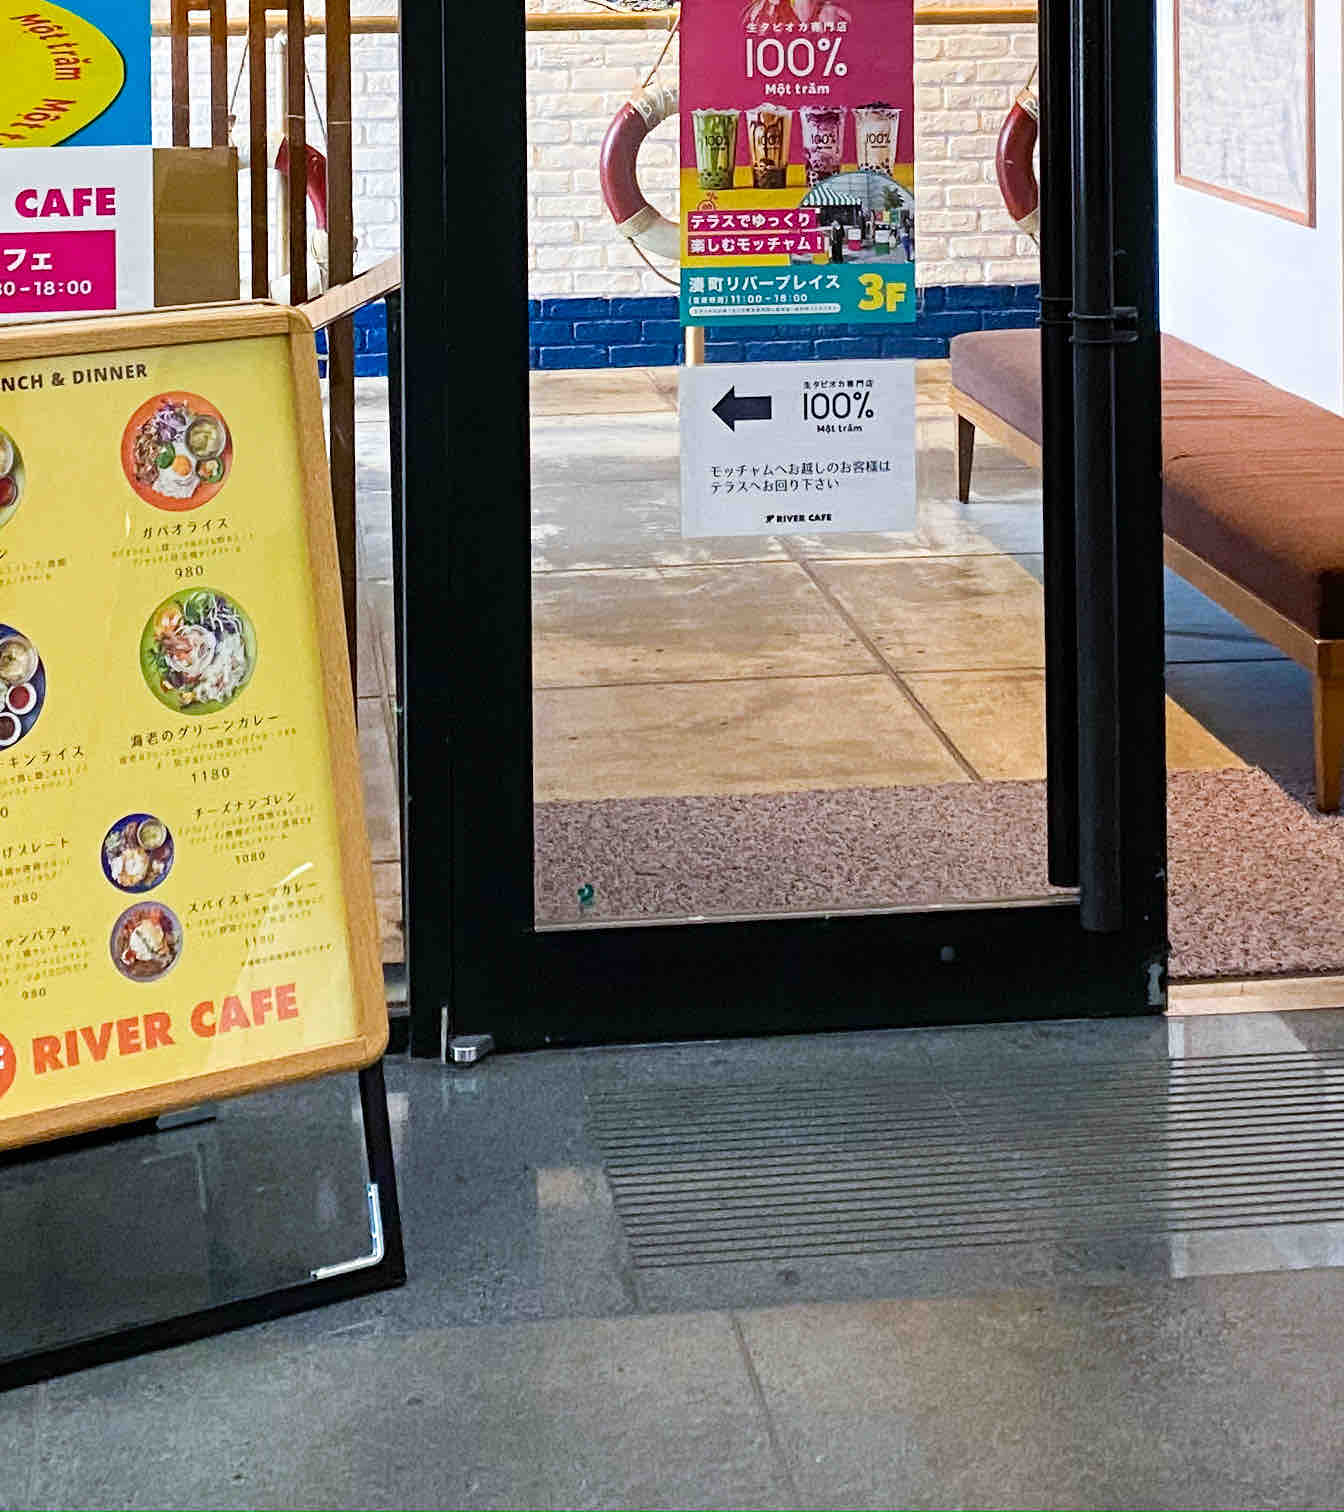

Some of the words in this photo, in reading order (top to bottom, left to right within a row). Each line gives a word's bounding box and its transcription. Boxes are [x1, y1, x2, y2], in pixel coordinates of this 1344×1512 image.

[746, 37, 848, 78] 100%
[15, 188, 116, 218] CAFE
[690, 212, 810, 229] テラスでゆっくり
[858, 273, 906, 312] 3F
[51, 371, 65, 387] &
[72, 362, 148, 385] DINNER
[803, 391, 874, 421] 100%
[31, 1011, 176, 1076] RIVER
[190, 983, 300, 1039] CAFE
